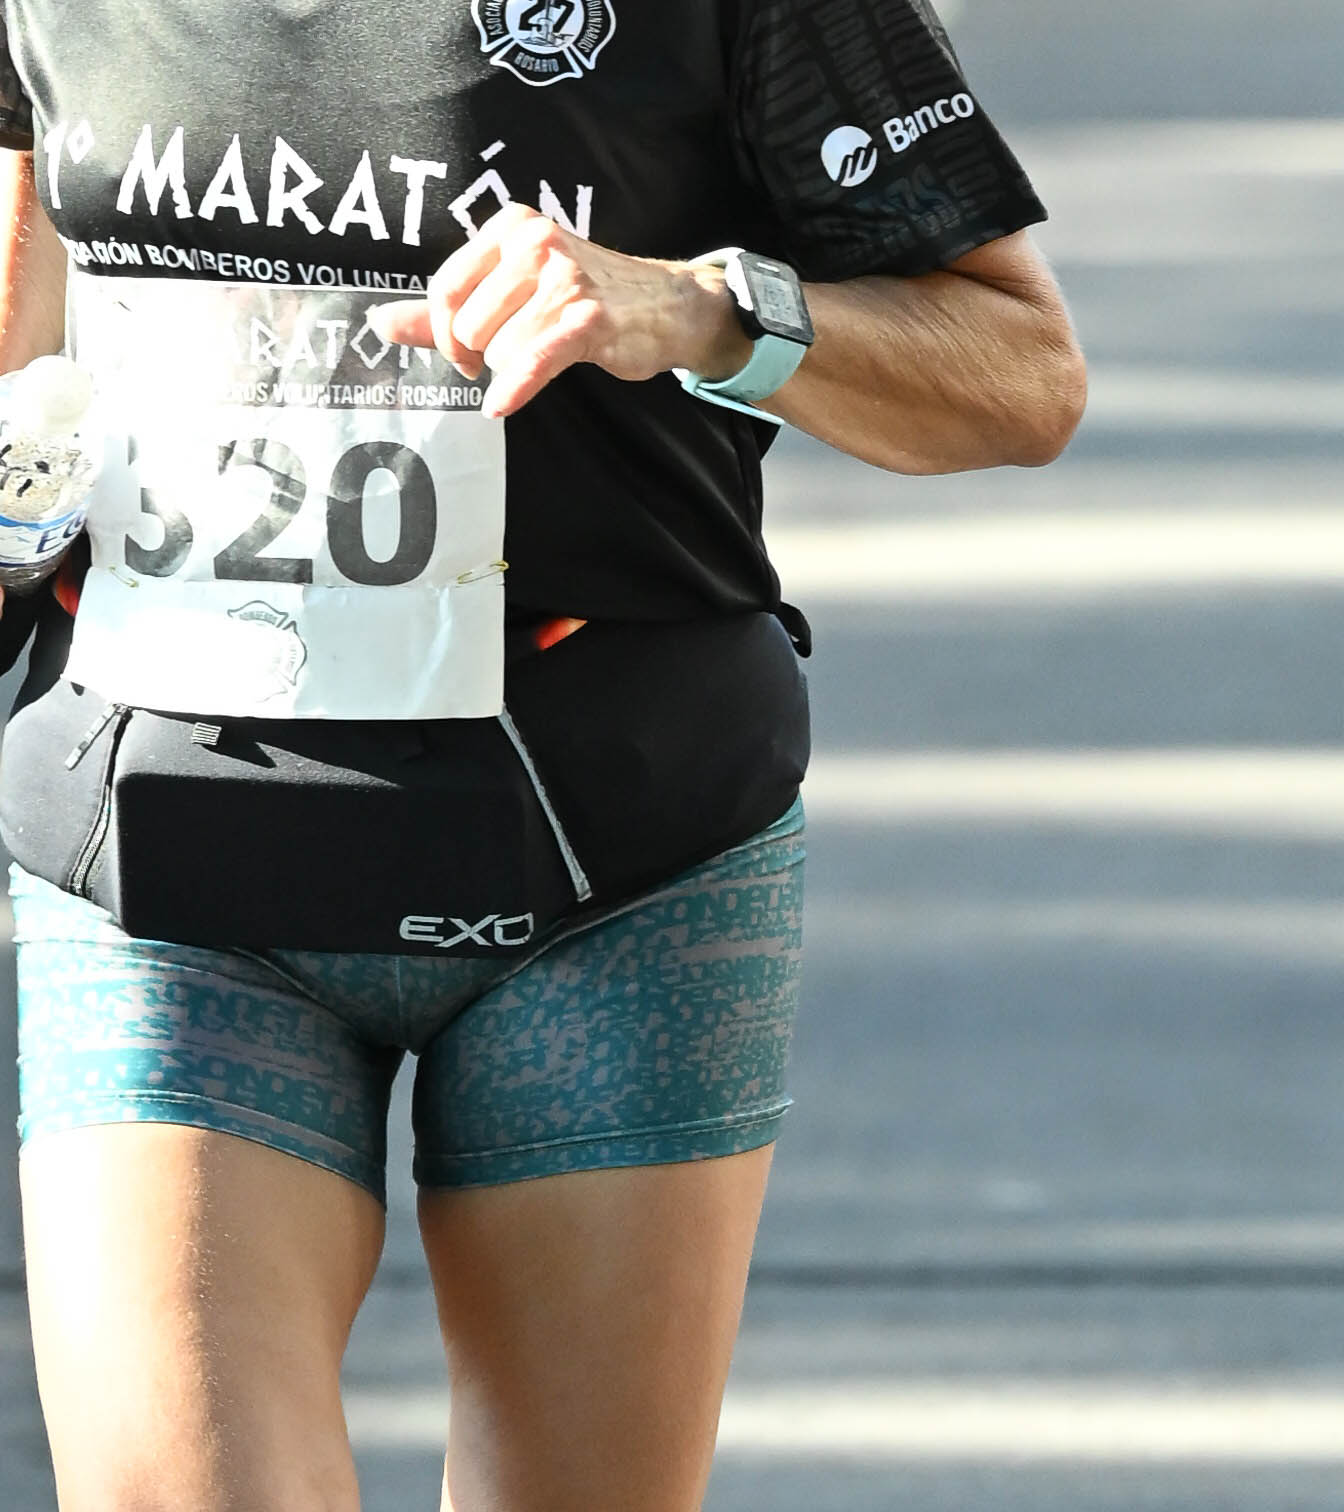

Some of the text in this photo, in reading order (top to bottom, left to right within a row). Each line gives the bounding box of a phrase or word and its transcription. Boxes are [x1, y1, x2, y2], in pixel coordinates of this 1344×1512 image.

[514, 51, 560, 74] ROSARIO
[882, 92, 976, 154] Banco
[116, 122, 594, 248] MARATÓN
[144, 243, 291, 284] BOMBEROS
[273, 382, 397, 409] VOLUNTARIOS
[400, 384, 482, 408] ROSARIO
